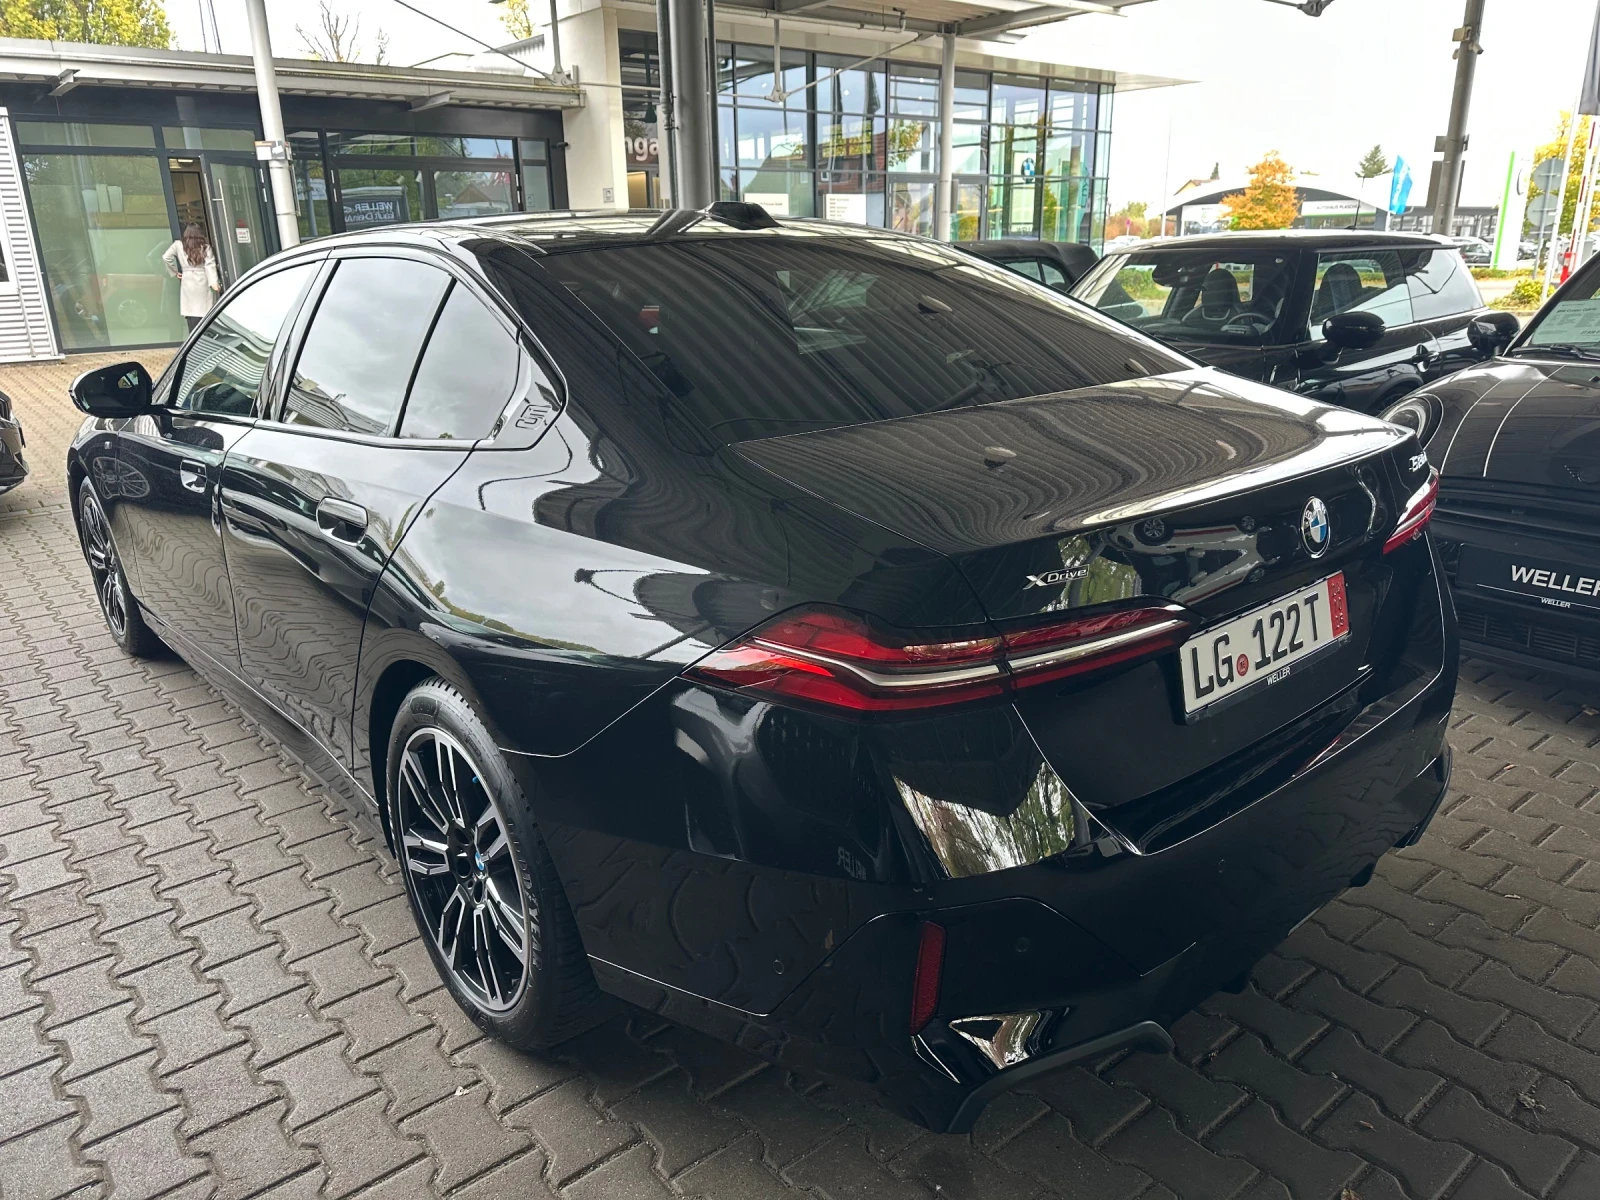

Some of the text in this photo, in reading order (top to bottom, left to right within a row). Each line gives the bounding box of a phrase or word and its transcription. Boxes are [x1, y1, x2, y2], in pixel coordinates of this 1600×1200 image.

[1541, 597, 1571, 608] WELLER
[1191, 632, 1235, 699] LG
[1267, 666, 1291, 686] WELLER
